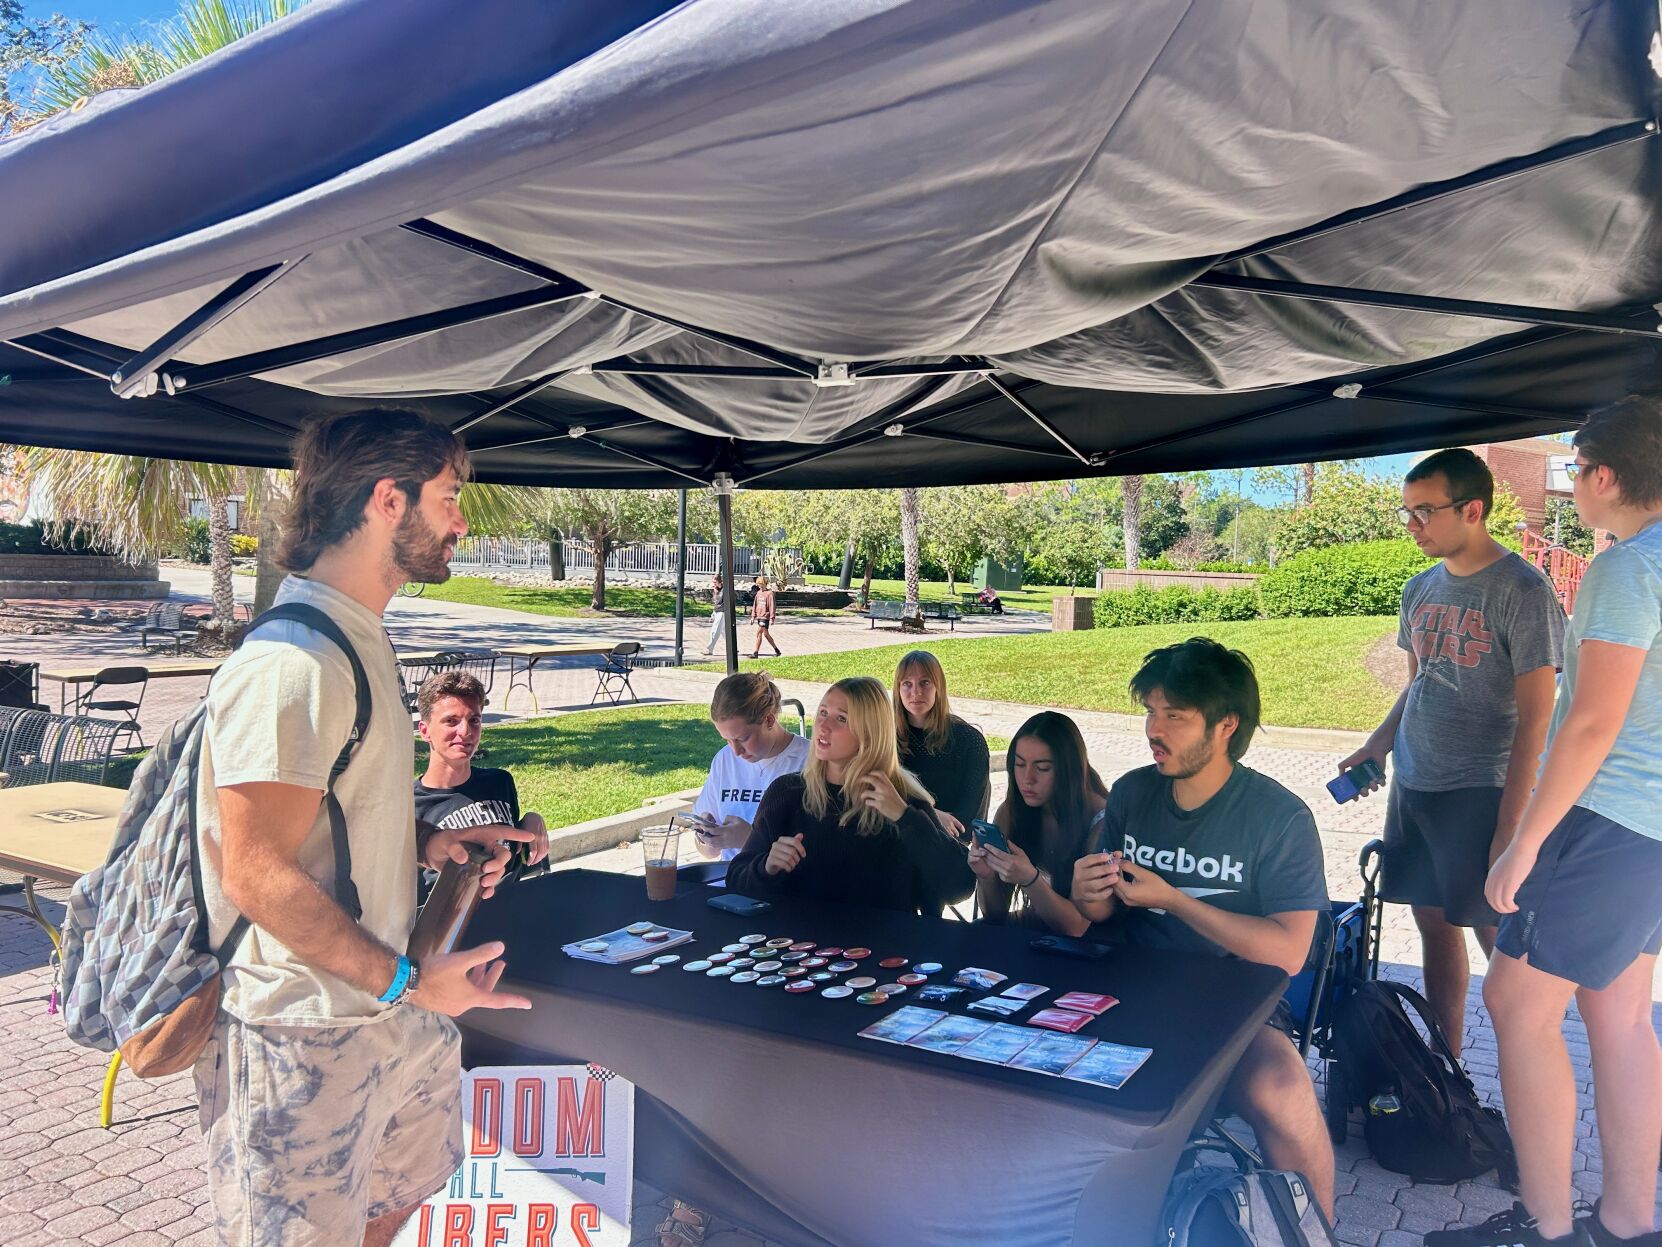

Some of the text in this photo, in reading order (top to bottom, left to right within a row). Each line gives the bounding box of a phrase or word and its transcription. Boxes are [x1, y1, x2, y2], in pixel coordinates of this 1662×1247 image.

[1411, 604, 1492, 642] STAR
[1123, 833, 1244, 883] Reebok
[469, 1077, 606, 1158] DOM
[449, 1162, 504, 1199] ALL
